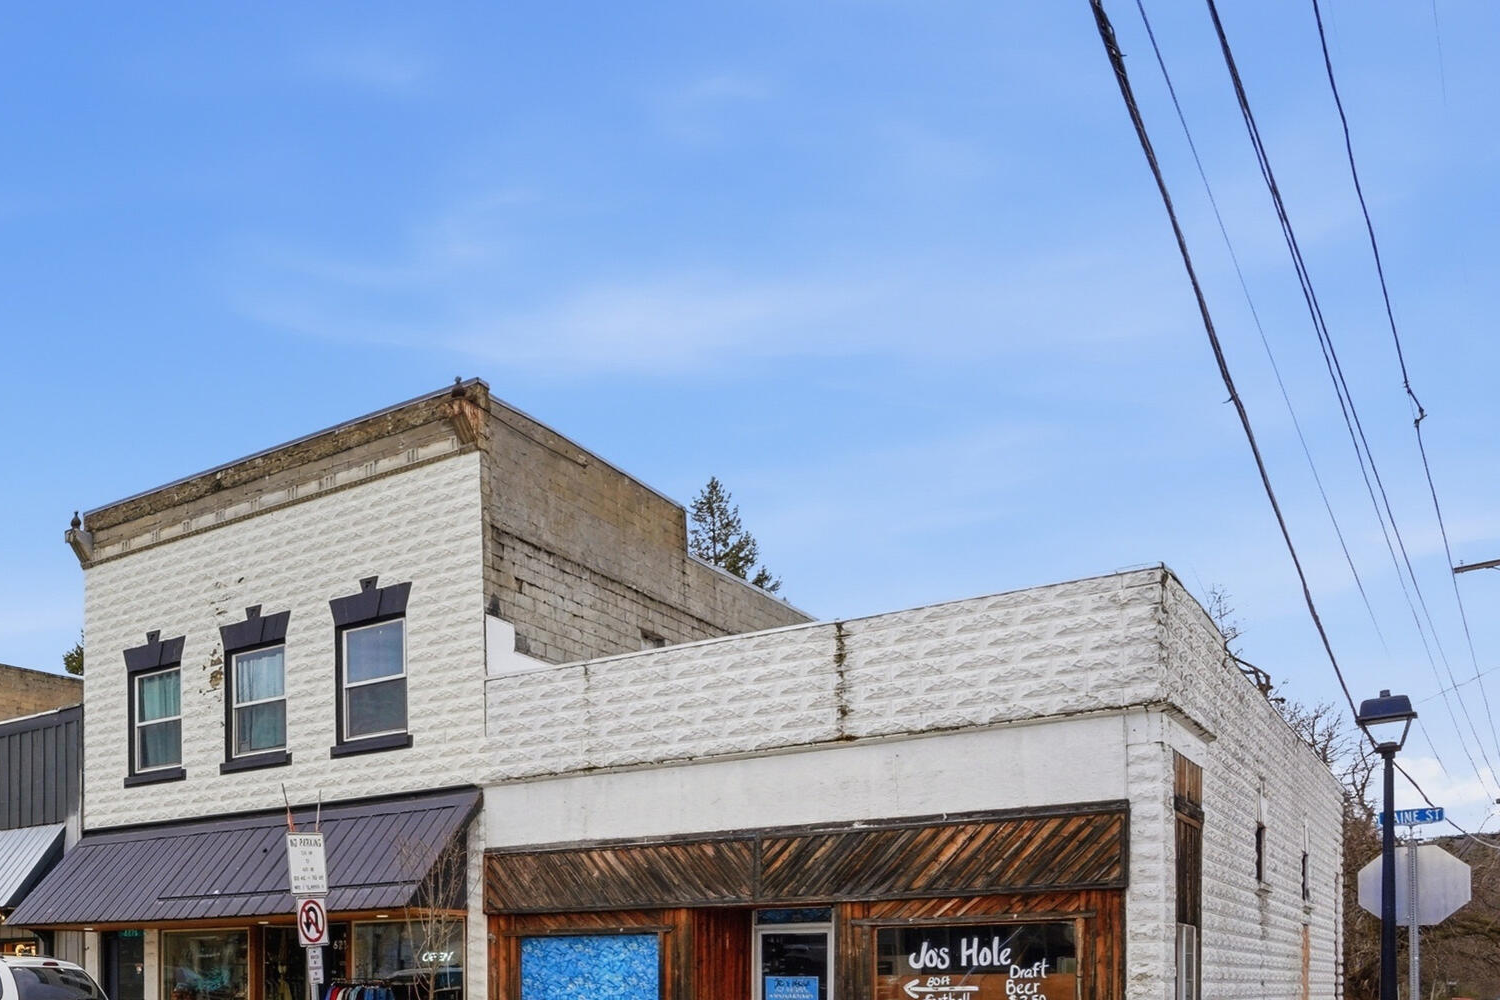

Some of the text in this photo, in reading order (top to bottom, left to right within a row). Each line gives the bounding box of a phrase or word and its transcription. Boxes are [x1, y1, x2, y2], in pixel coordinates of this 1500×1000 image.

[1393, 809, 1440, 824] AINE ST
[960, 936, 1012, 967] Hole
[1009, 958, 1049, 979] Draft
[1006, 979, 1041, 995] Beer
